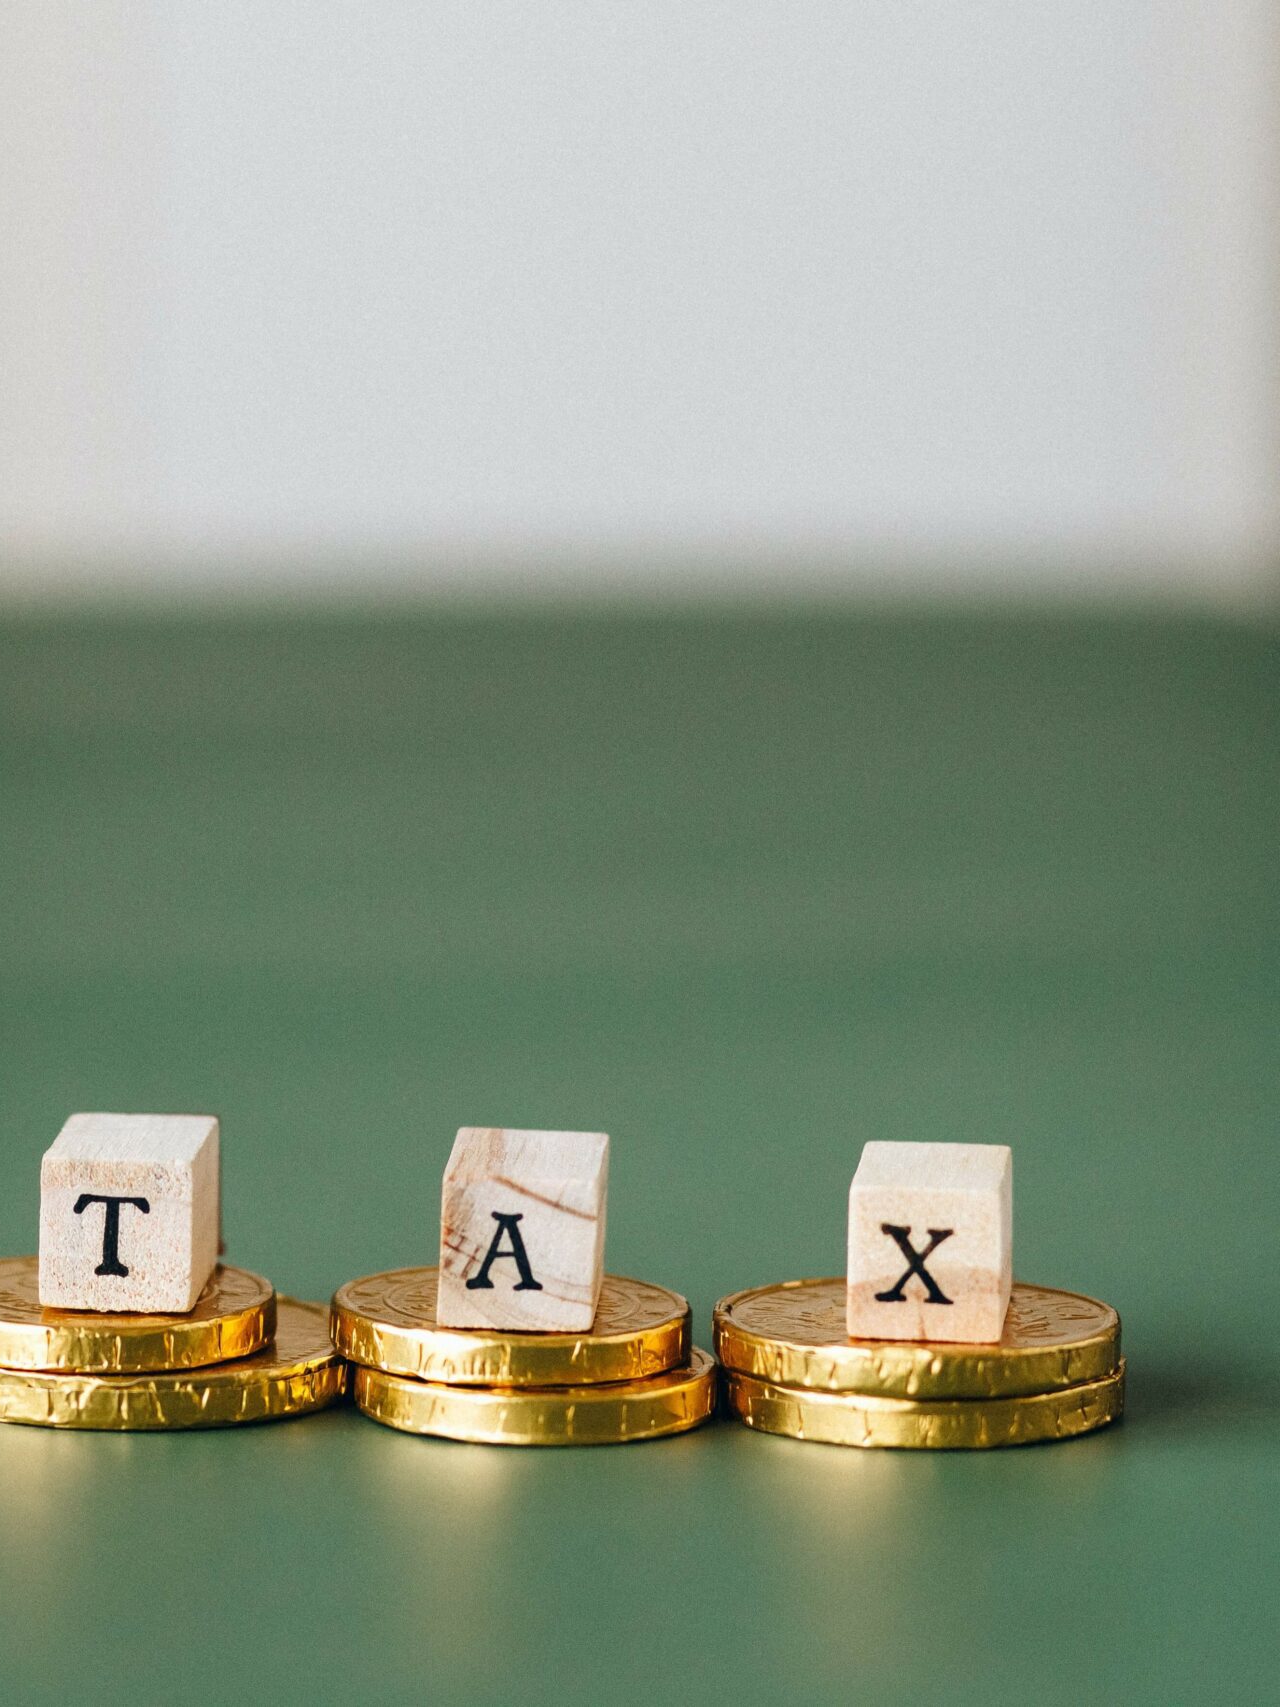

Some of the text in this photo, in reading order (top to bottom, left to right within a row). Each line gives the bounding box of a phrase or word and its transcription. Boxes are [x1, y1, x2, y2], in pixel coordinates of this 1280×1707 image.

[73, 1193, 954, 1305] T A X
